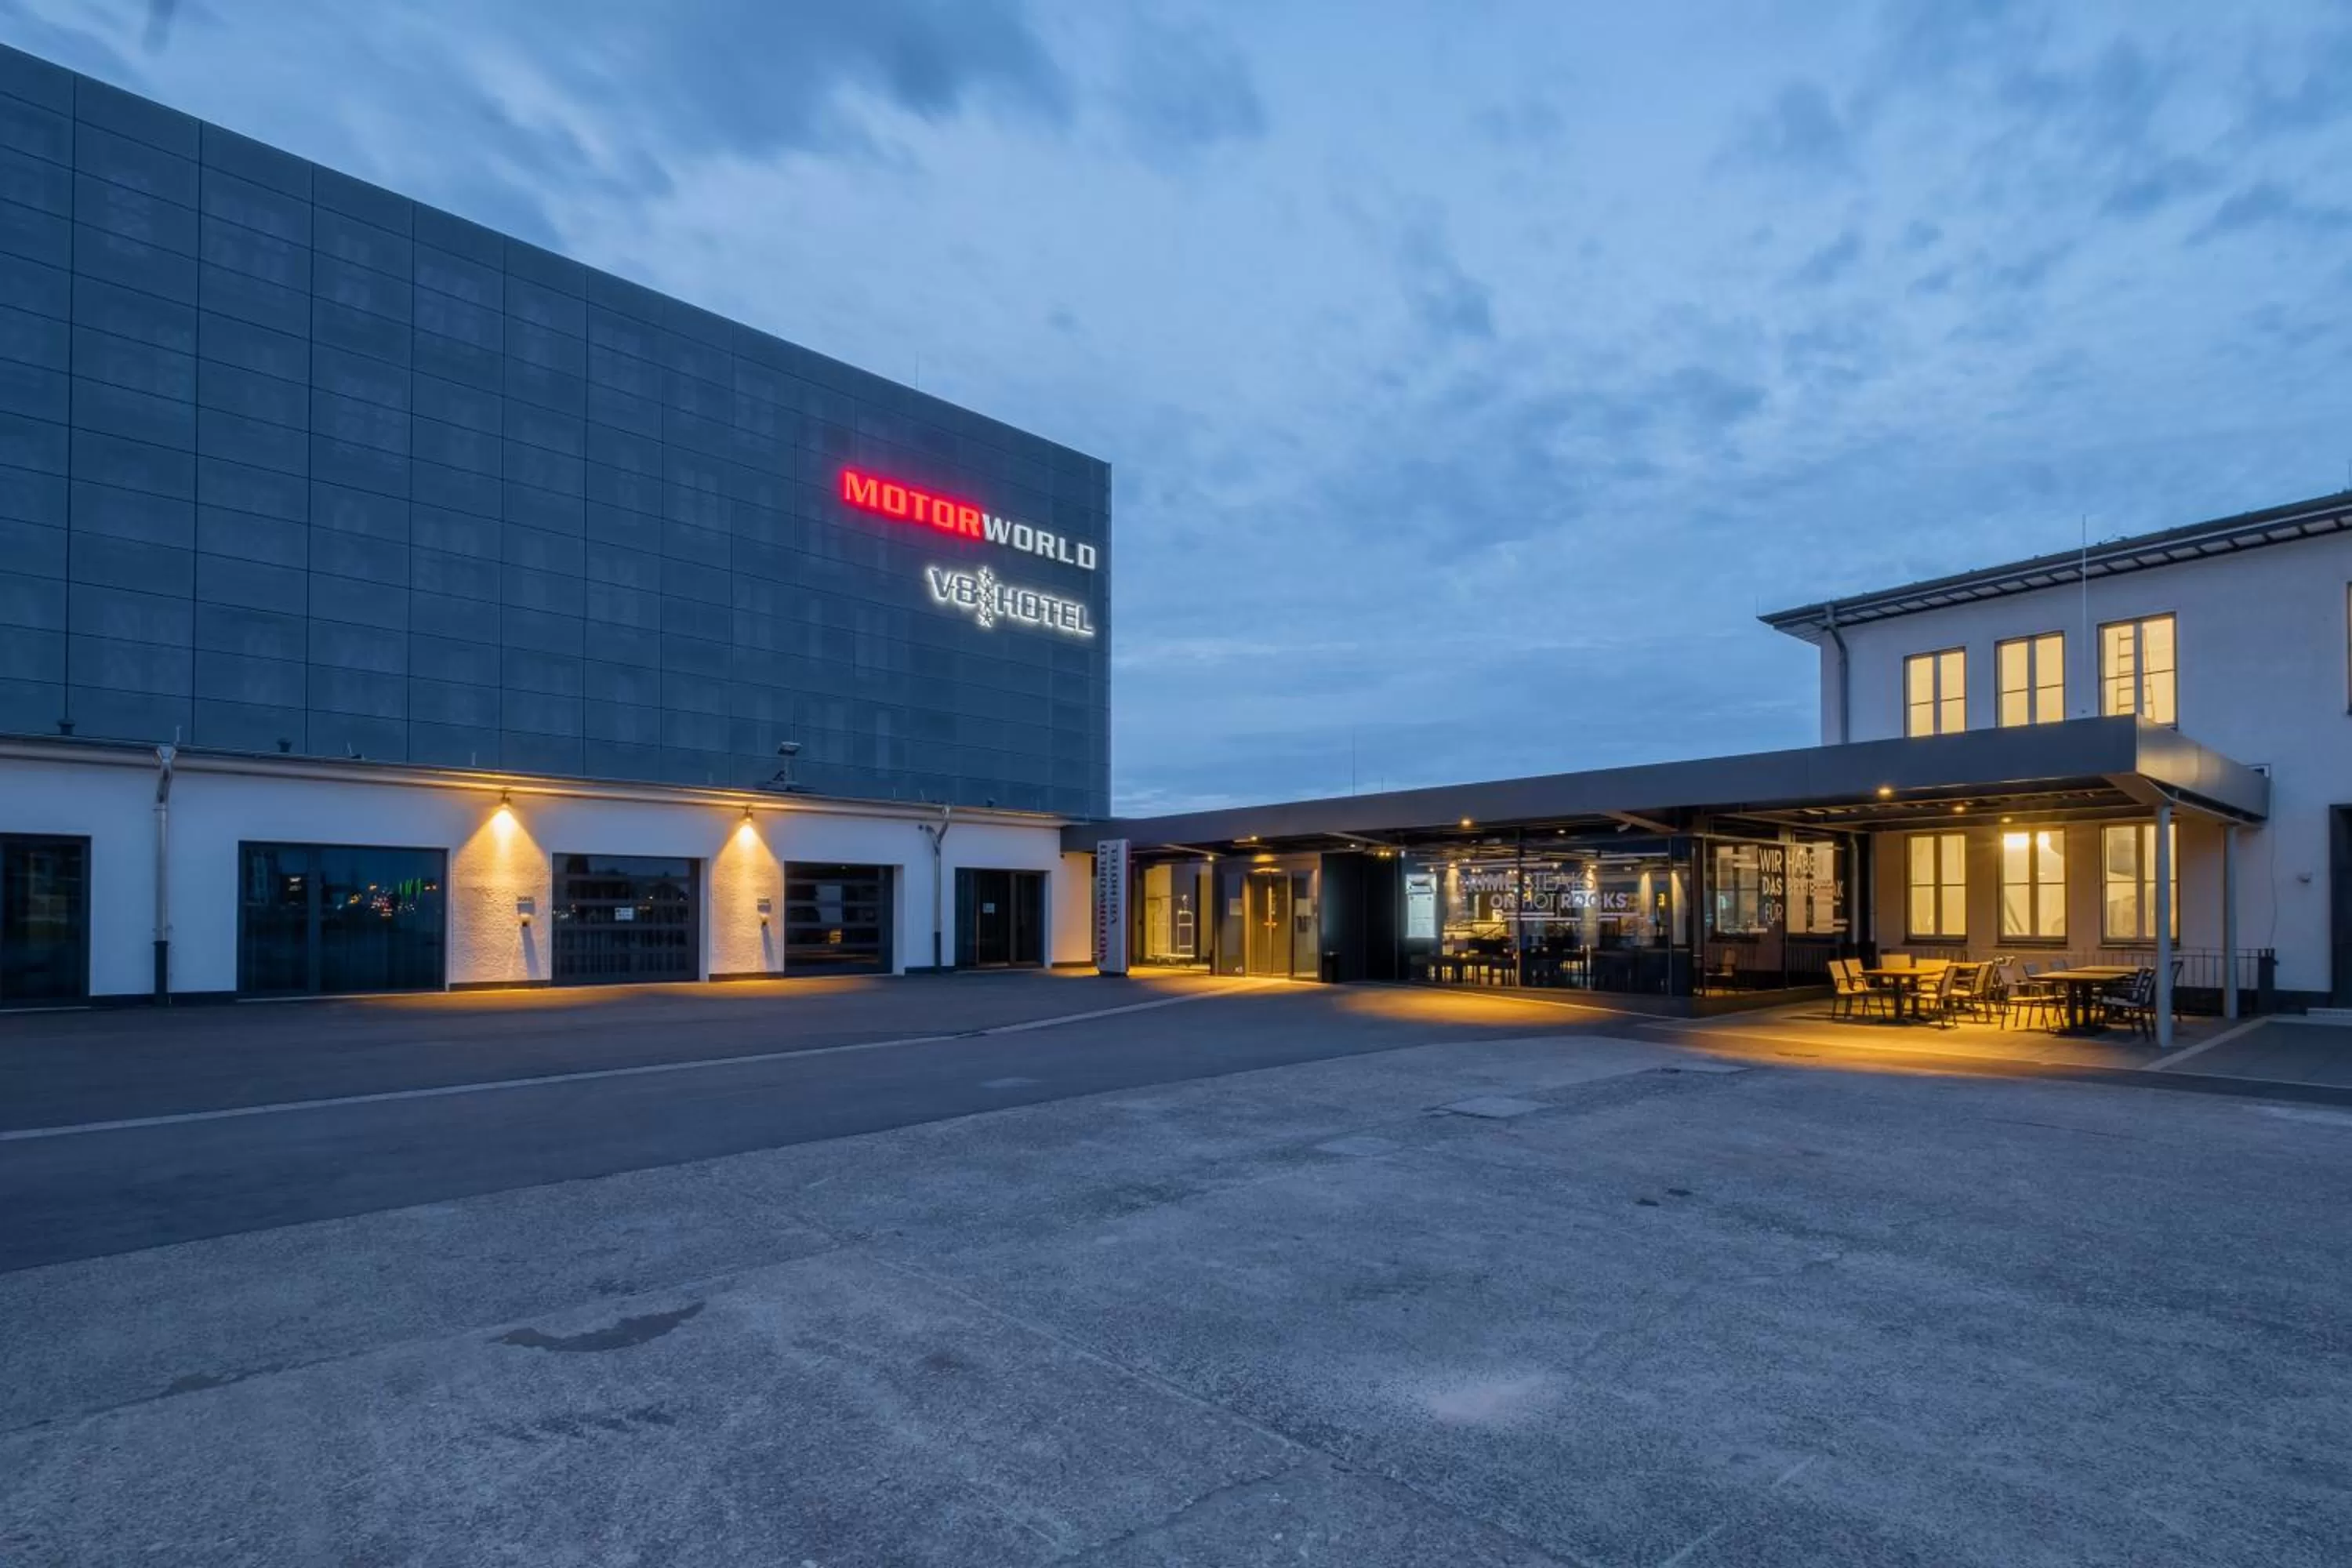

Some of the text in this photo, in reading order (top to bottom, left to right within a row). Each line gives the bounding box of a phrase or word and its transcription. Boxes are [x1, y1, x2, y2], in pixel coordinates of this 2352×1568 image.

[844, 471, 1096, 570] MOTORWORLD
[928, 566, 1094, 636] V8 HOTEL
[1759, 848, 1827, 877] WIR HABE
[1762, 876, 1783, 896] DAS
[1490, 893, 1516, 909] ON
[1522, 892, 1555, 909] HOT
[1765, 899, 1784, 923] FÜR
